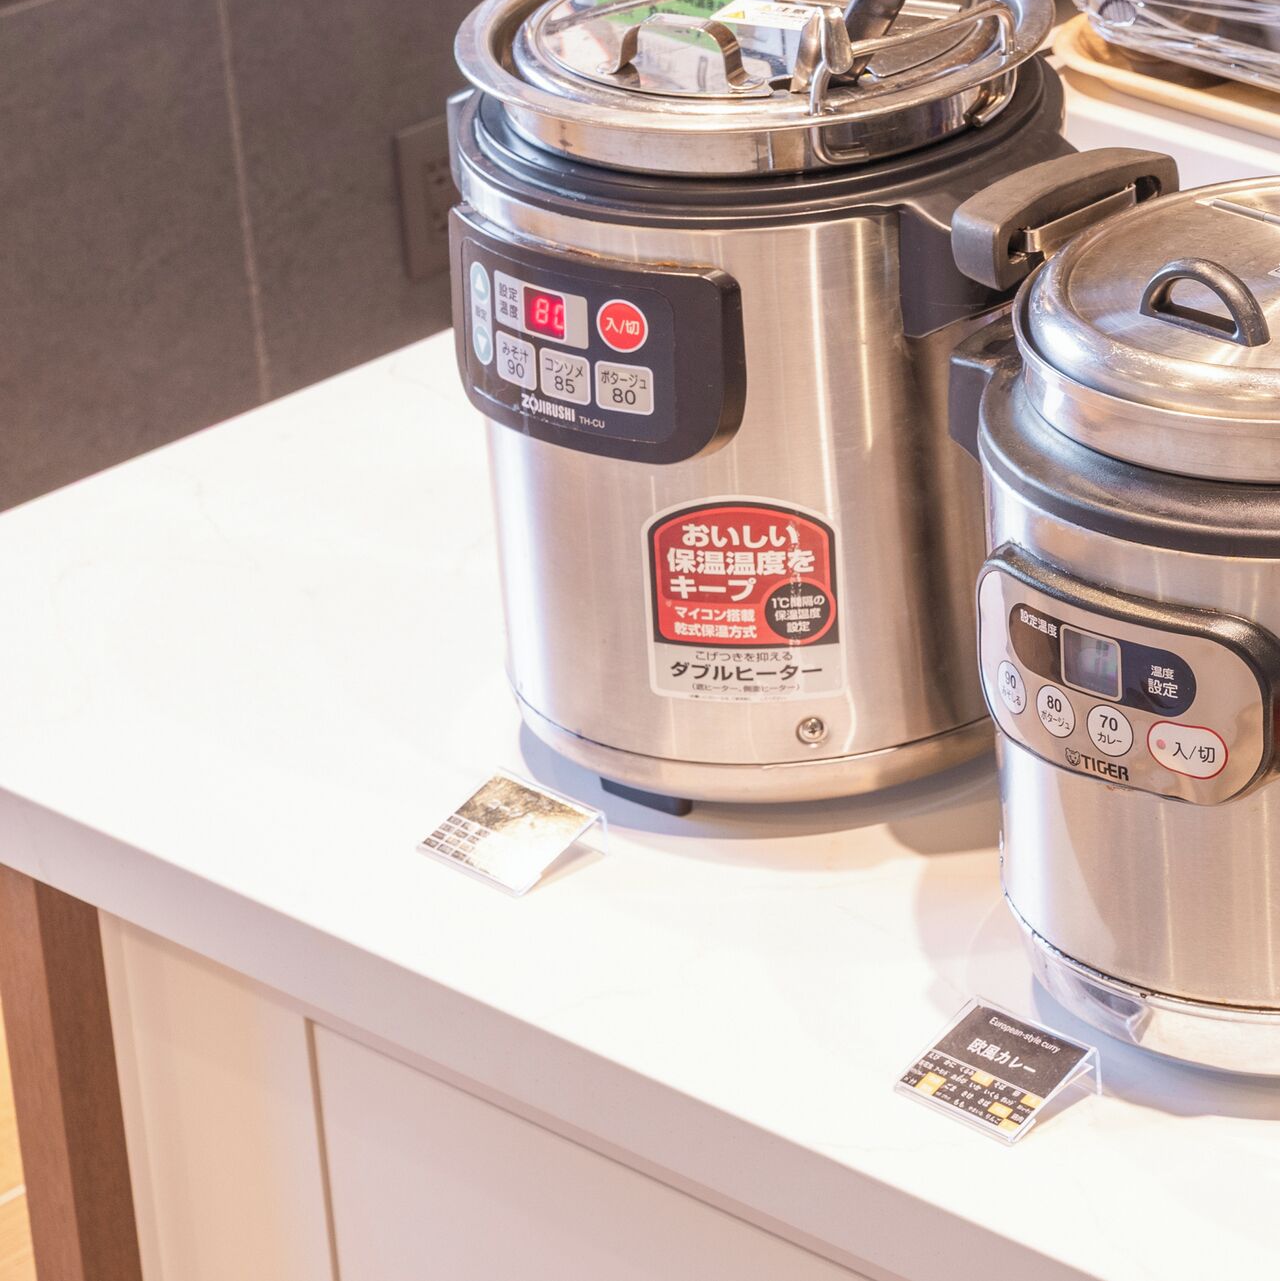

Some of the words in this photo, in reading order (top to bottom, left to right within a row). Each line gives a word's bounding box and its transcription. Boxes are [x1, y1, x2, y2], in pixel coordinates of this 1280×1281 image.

[605, 316, 640, 336] 入/切
[502, 341, 529, 365] みそ汁
[506, 359, 525, 380] 90
[545, 357, 584, 378] コンソメ
[554, 375, 575, 394] 85
[600, 370, 648, 390] ポタージュ
[612, 387, 636, 406] 80
[521, 393, 576, 422] ZOJIRUSHI
[682, 522, 800, 549] おいしい
[667, 547, 816, 577] 保温温度を
[670, 575, 757, 602] キープ
[674, 605, 756, 623] マイコン搭載
[774, 609, 822, 622] 保温温度
[1019, 608, 1058, 639] 設定温度
[674, 622, 758, 639] 乾式保温方式
[786, 621, 811, 634] 設定
[695, 650, 793, 663] こげつきを抑える
[671, 661, 823, 682] ダブルヒーター
[1004, 670, 1017, 690] 90
[1150, 664, 1175, 681] 温度
[1147, 677, 1179, 700] 設定
[1046, 695, 1062, 714] 80
[1040, 709, 1071, 731] ポタージュ
[1099, 714, 1119, 732] 70
[1096, 731, 1123, 745] カレー
[1171, 741, 1217, 764] 入/切
[1080, 754, 1130, 782] TIGER
[988, 1016, 1041, 1047] European-style
[1041, 1040, 1061, 1055] curry
[967, 1037, 1037, 1074] 欧風カレー
